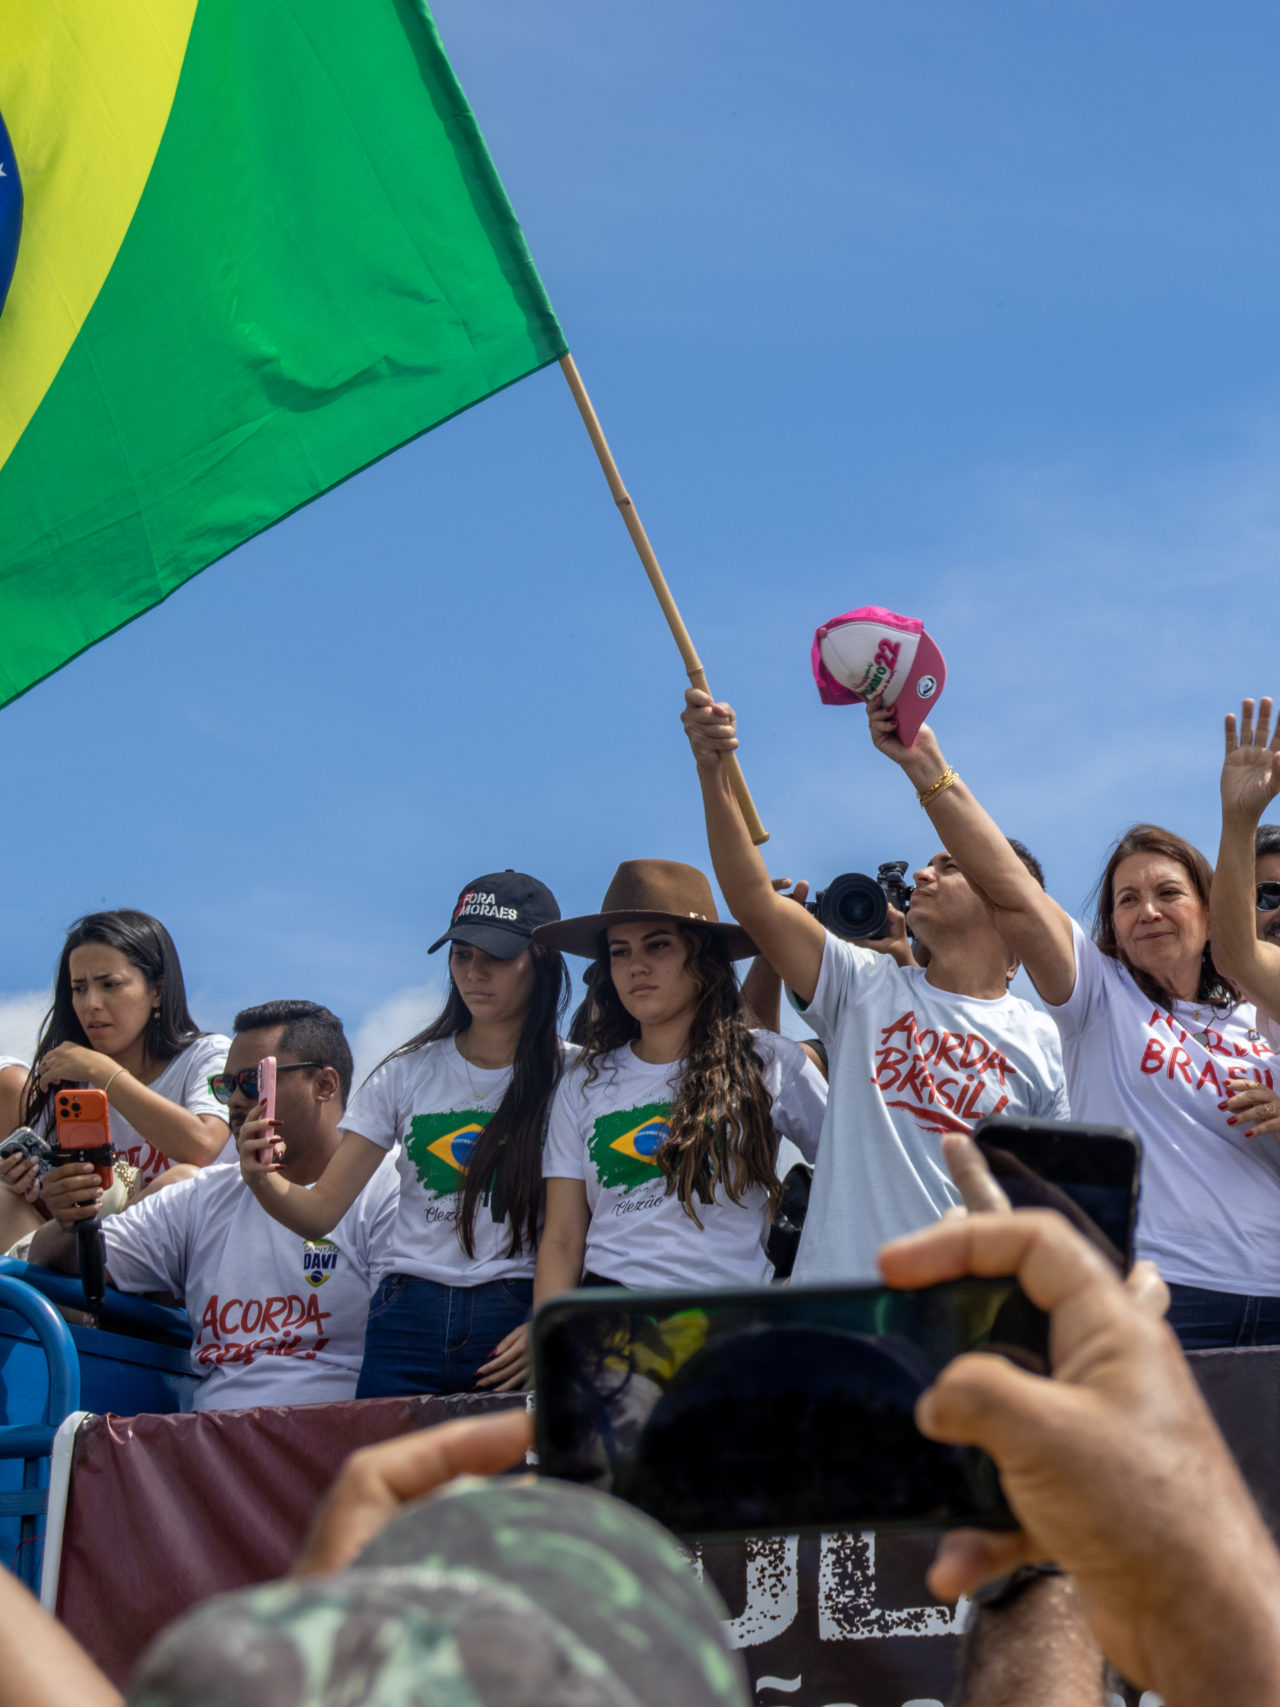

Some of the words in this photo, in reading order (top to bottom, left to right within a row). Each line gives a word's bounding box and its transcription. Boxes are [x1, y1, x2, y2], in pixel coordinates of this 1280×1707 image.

[462, 891, 496, 905] FORA
[459, 904, 518, 921] MORAES
[303, 1252, 338, 1270] DAVI
[196, 1293, 332, 1346] ACORDA
